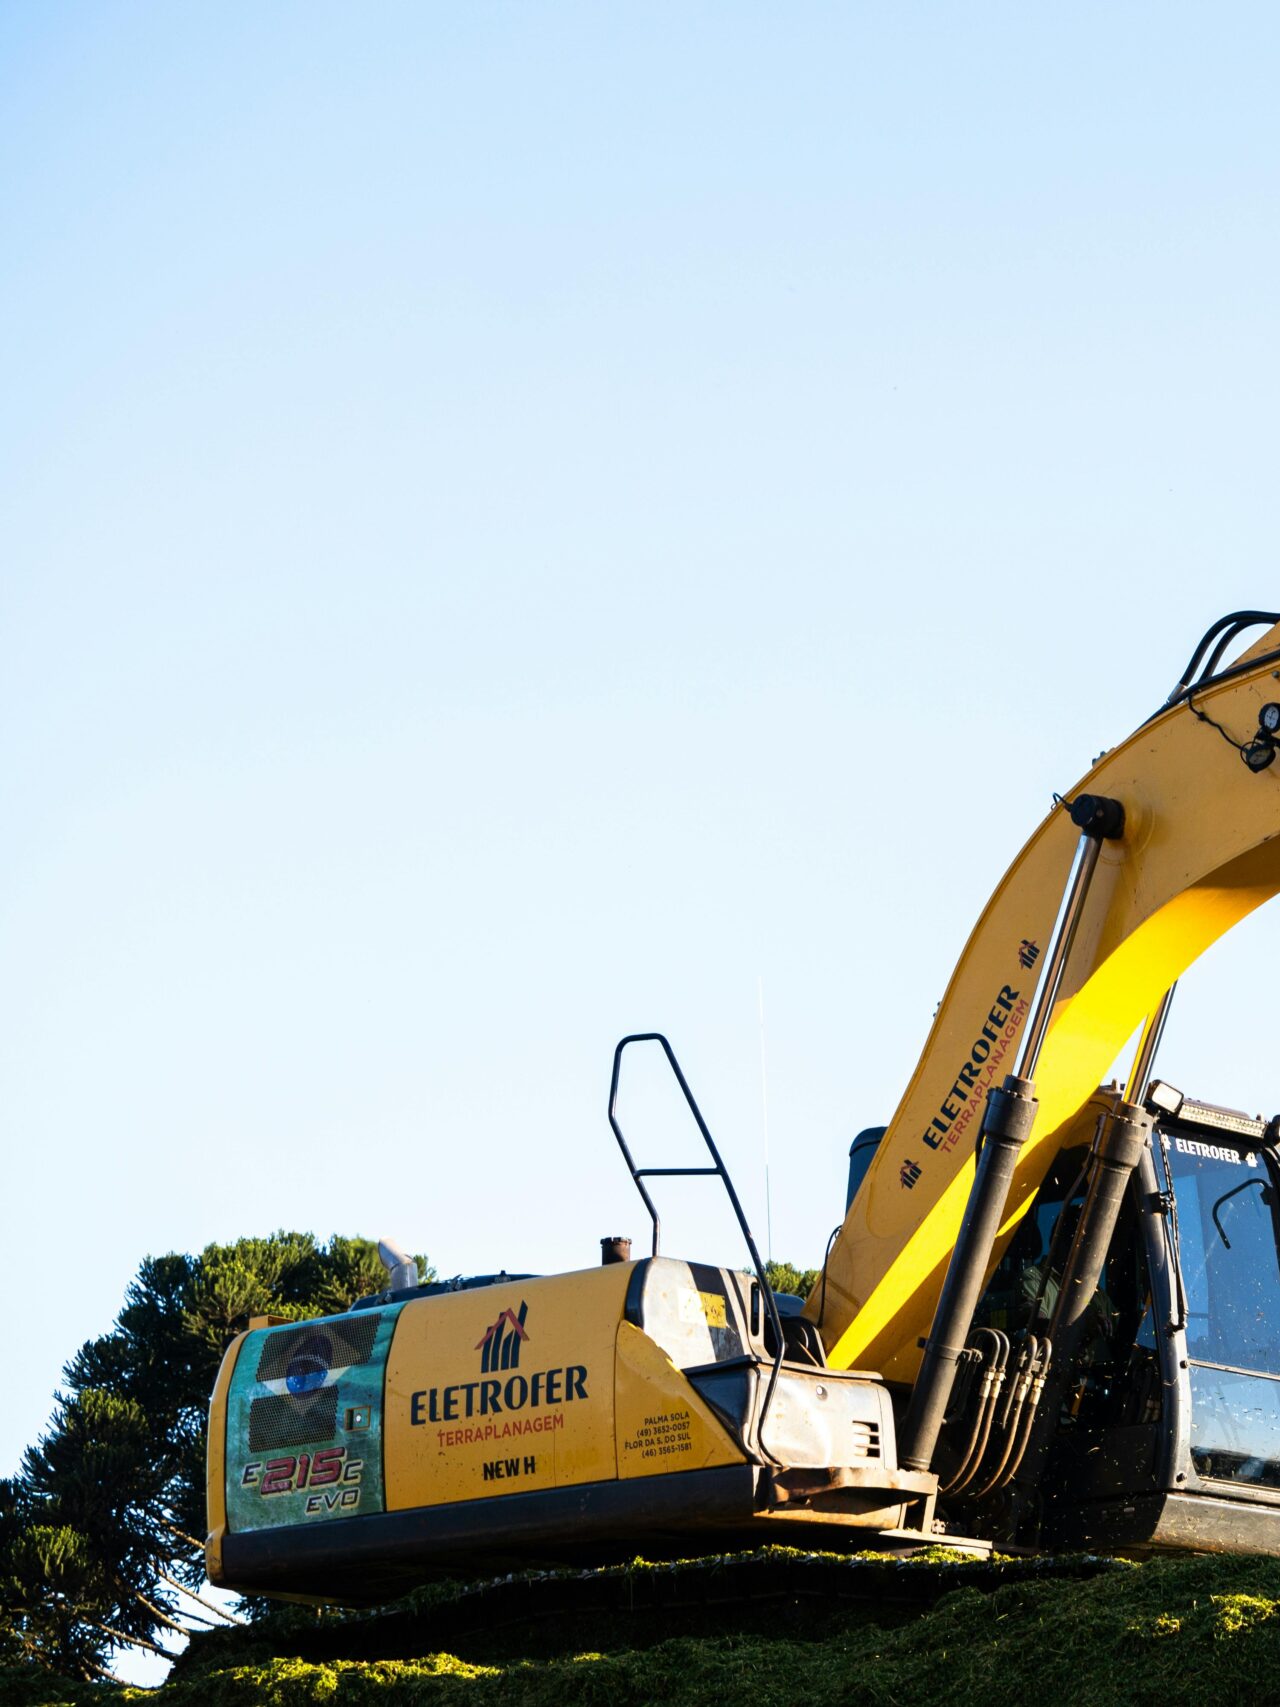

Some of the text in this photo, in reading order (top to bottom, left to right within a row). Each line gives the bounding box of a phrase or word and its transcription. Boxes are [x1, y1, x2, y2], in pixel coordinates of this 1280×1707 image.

[922, 984, 1020, 1151] ELETROFER
[940, 999, 1029, 1154] TERRAPLANAGEM
[1175, 1137, 1242, 1165] ELETROFER
[410, 1364, 589, 1427] ELETROFER
[437, 1412, 565, 1448] TERRAPLANAGEM
[644, 1411, 690, 1426] PALMA SOLA
[624, 1432, 691, 1450] FLOR DA S. DO SUL
[637, 1428, 652, 1439] (49)
[642, 1448, 657, 1459] (46)
[483, 1457, 520, 1481] NEW
[305, 1488, 360, 1514] EVO
